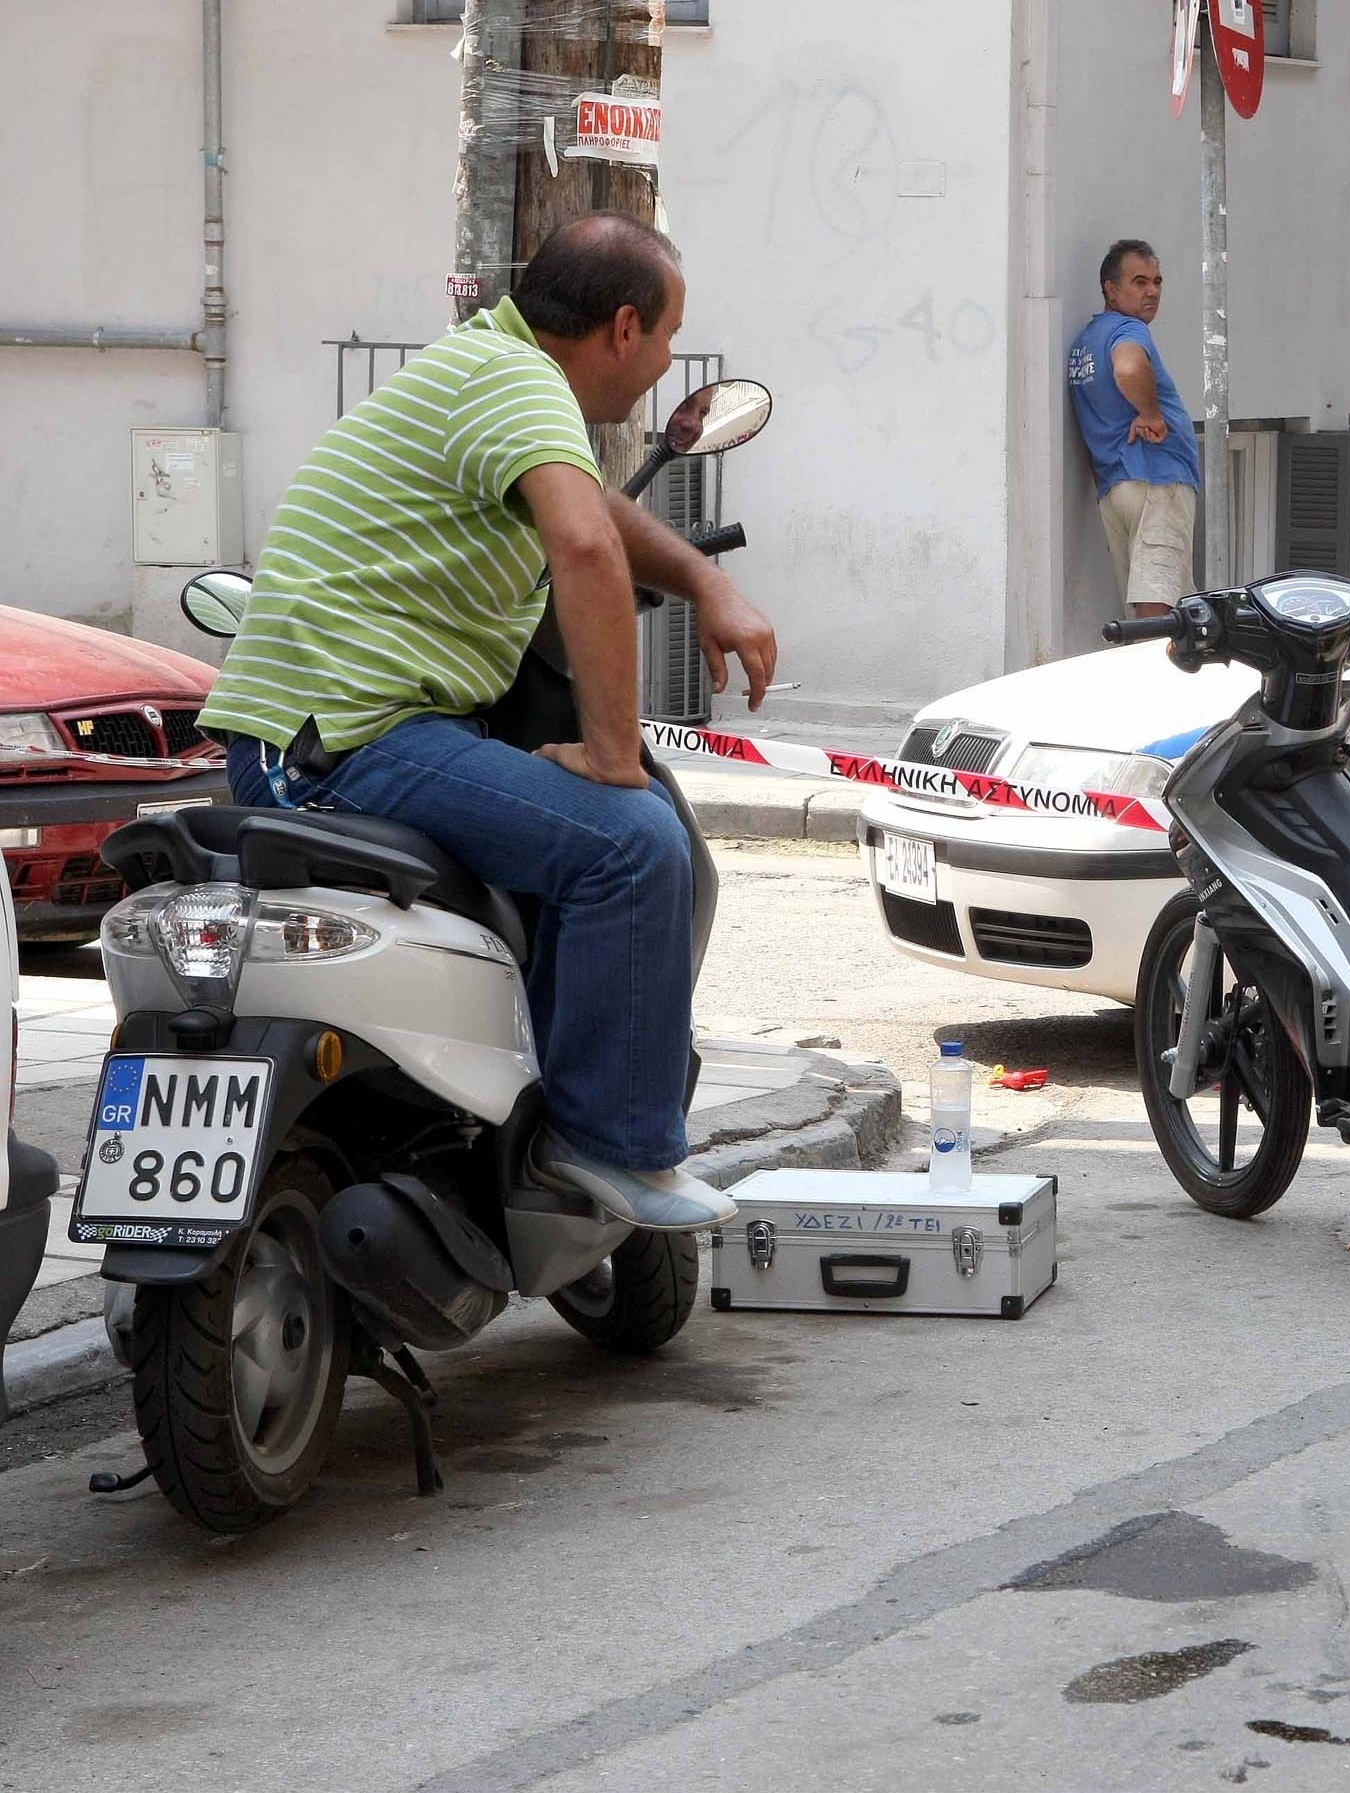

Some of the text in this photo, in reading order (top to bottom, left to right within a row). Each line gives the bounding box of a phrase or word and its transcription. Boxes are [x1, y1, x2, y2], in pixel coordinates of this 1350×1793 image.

[578, 136, 631, 149] ΠΛΗΡΟΦΟΡΙΕΣ
[640, 722, 746, 759] ΥΝΟΜΙΑ
[830, 756, 1117, 819] ΕΛΛΗΝΙΚΗ ΑΣΤΥΝΟΜΙΑ
[102, 1074, 260, 1128] GR NMM
[128, 1149, 246, 1202] 860
